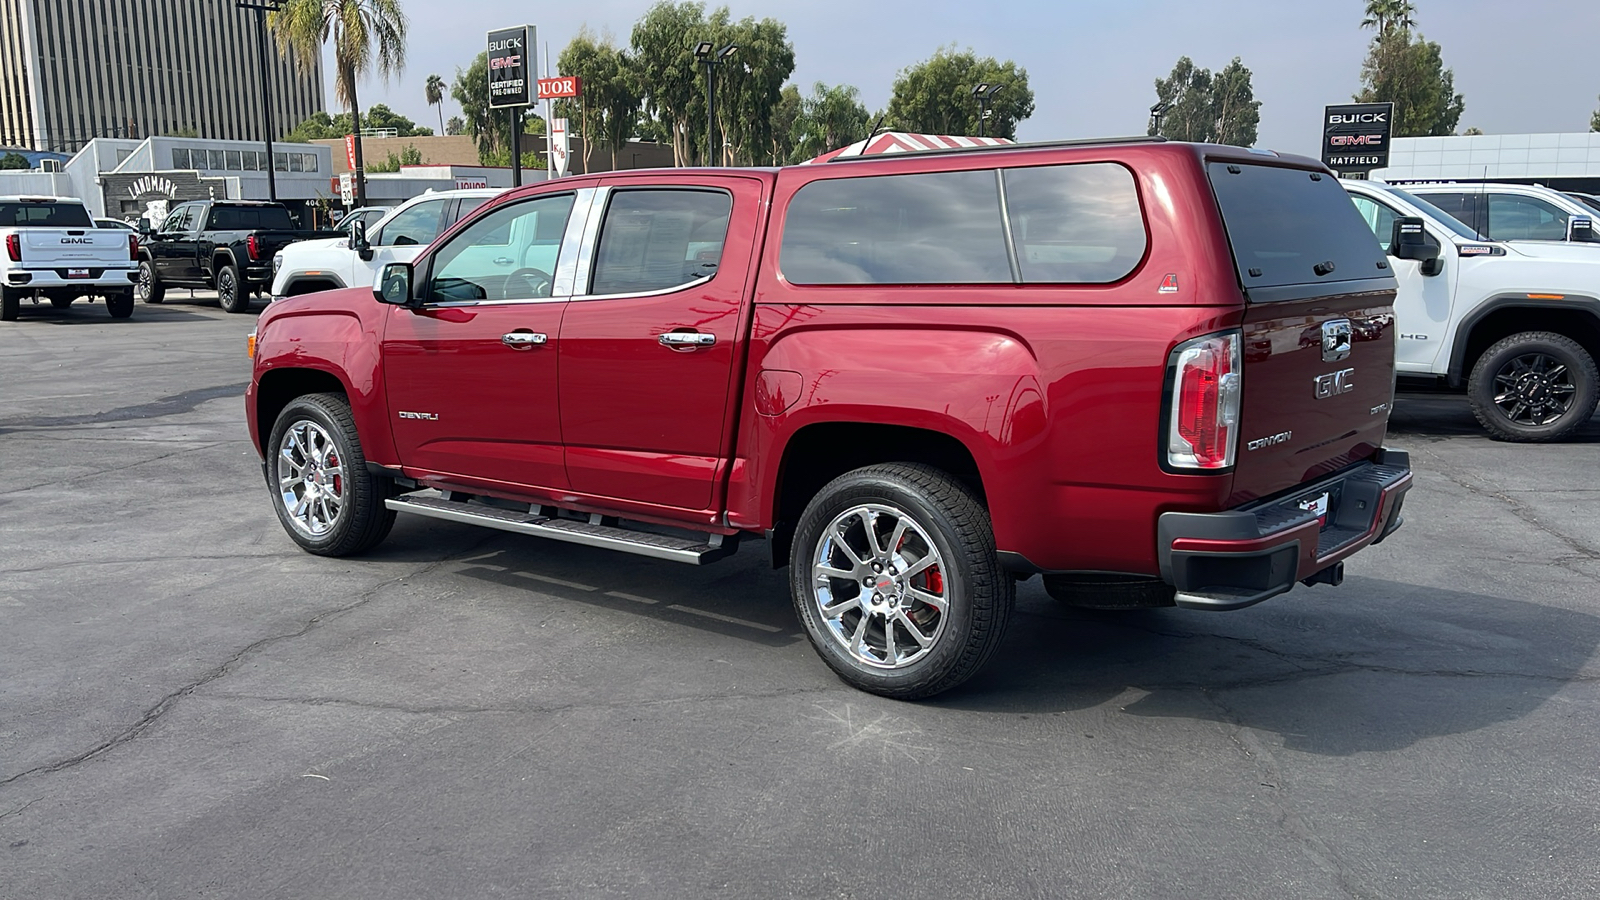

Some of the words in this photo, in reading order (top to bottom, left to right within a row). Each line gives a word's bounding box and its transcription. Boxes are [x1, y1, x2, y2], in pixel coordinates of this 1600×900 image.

[489, 37, 522, 52] BUICK
[490, 55, 521, 69] GMC
[491, 79, 524, 89] CERTIFIED
[492, 87, 522, 96] PRE-OWNED
[1329, 113, 1386, 124] BUICK
[1330, 134, 1382, 146] GMC
[1330, 156, 1379, 165] HATFIELD
[128, 176, 178, 199] LANDMARK
[343, 190, 352, 201] 30
[1314, 368, 1355, 400] GMC
[398, 411, 439, 420] DENALI
[1247, 430, 1292, 451] CANYON
